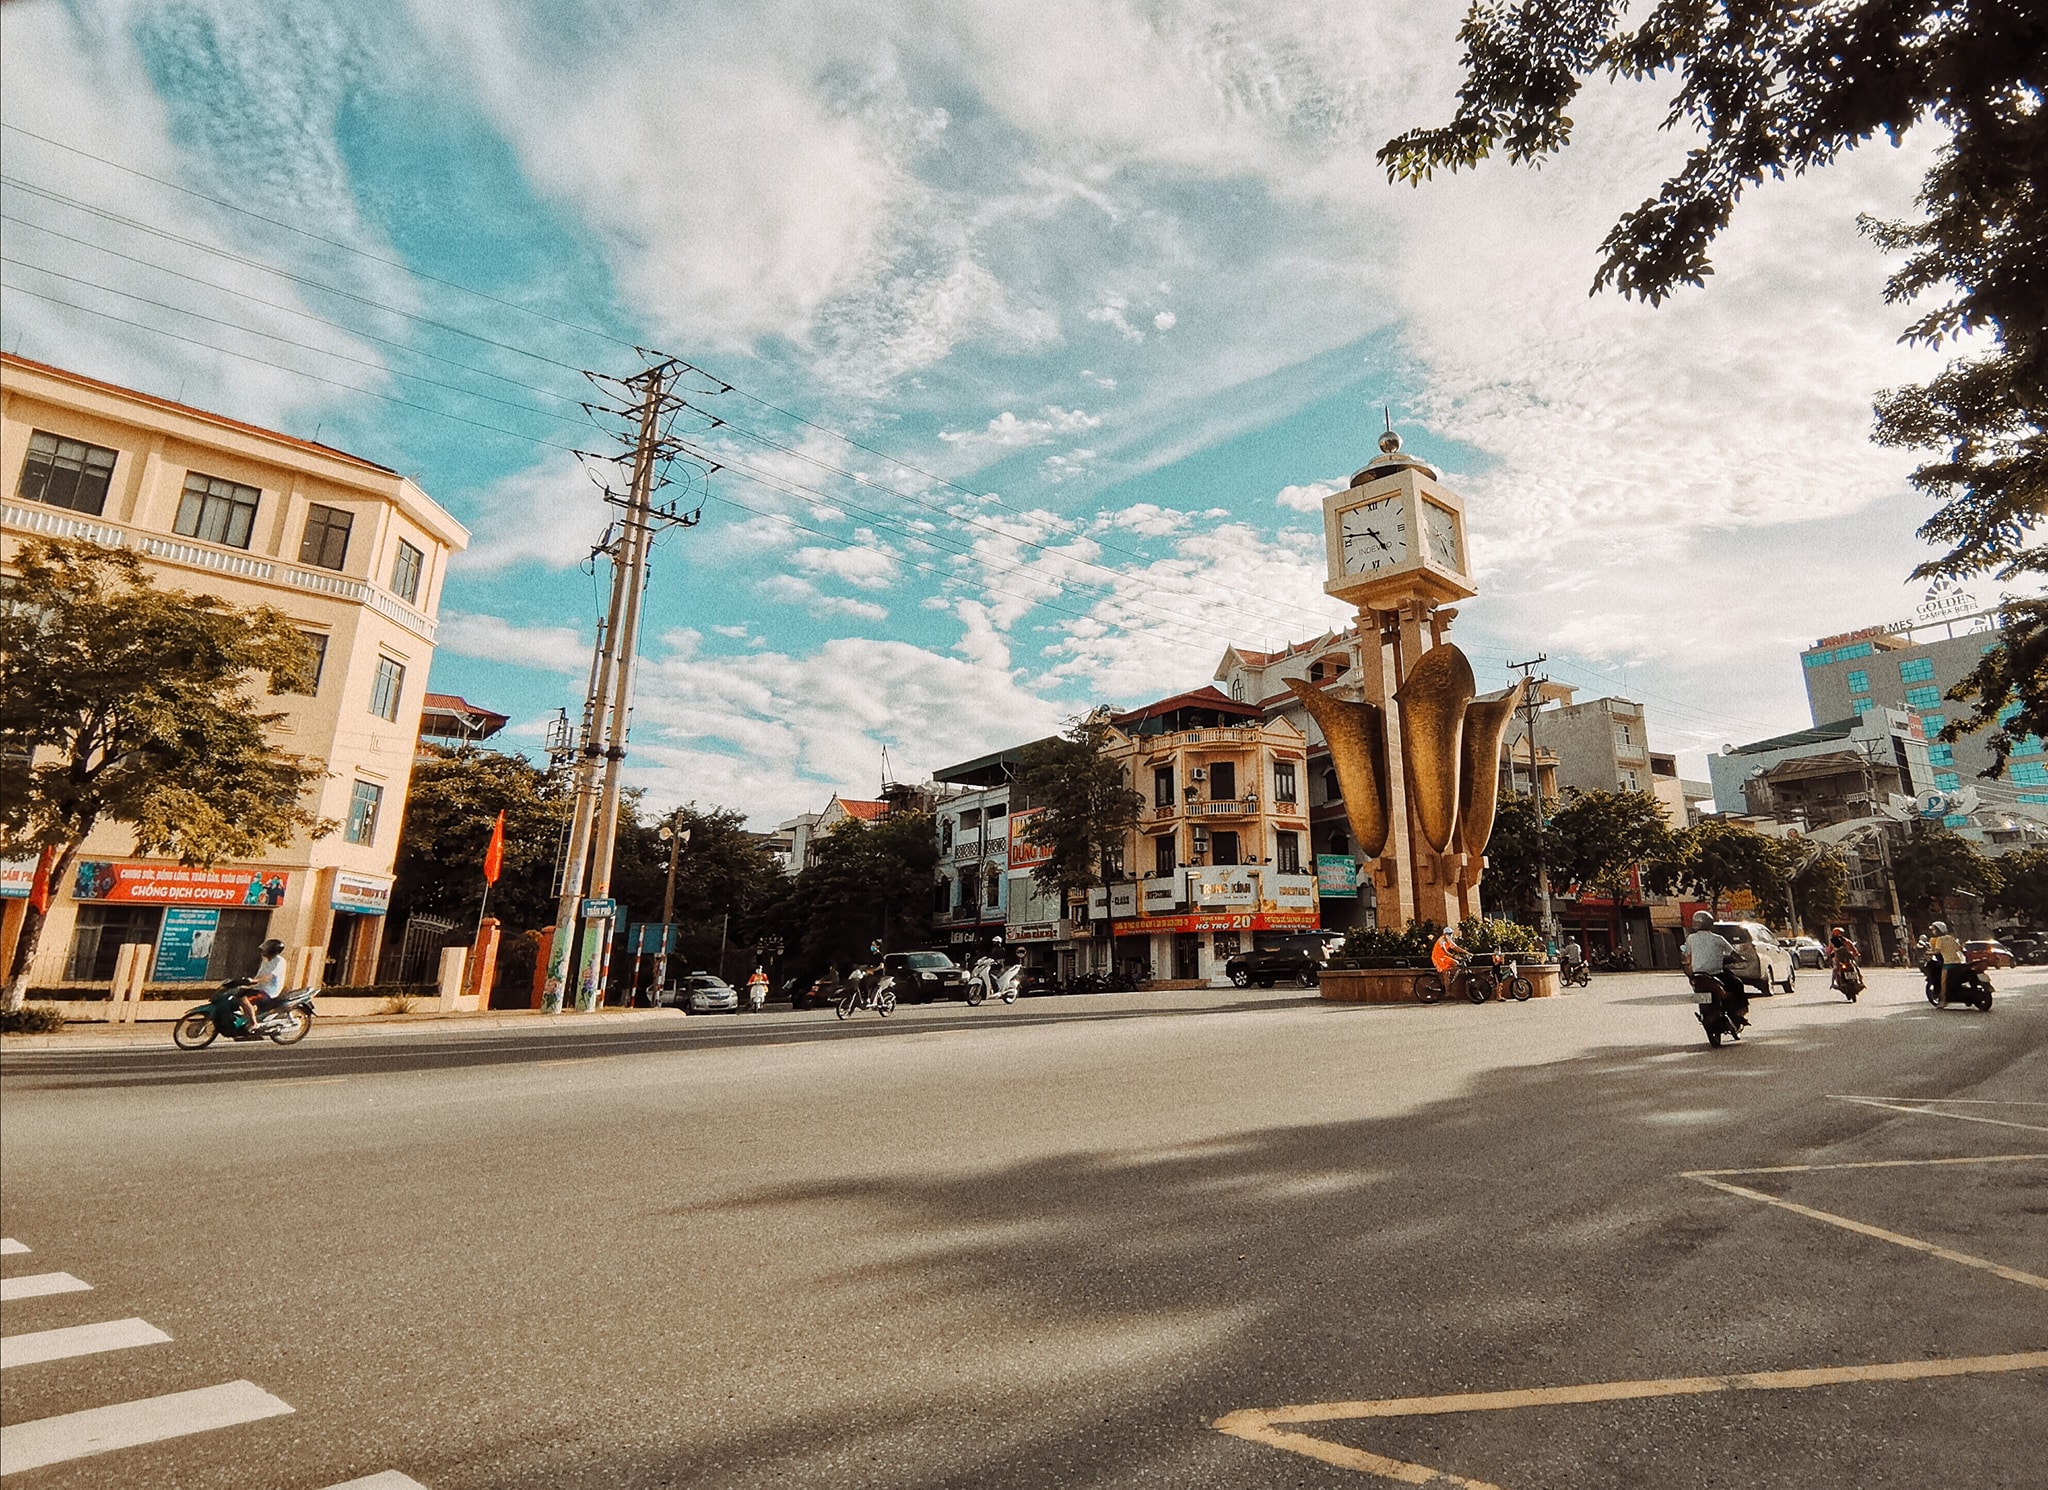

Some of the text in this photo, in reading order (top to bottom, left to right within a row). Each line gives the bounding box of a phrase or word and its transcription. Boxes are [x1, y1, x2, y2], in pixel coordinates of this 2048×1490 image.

[1367, 503, 1378, 512] XII
[1358, 541, 1393, 556] INDEVO
[1916, 592, 1977, 614] GOLDEN
[1879, 618, 1913, 635] AMES
[120, 869, 142, 879] CHUNG
[131, 882, 235, 900] CHỐNG DỊCH COVID-19
[1199, 883, 1228, 894] TRUNG
